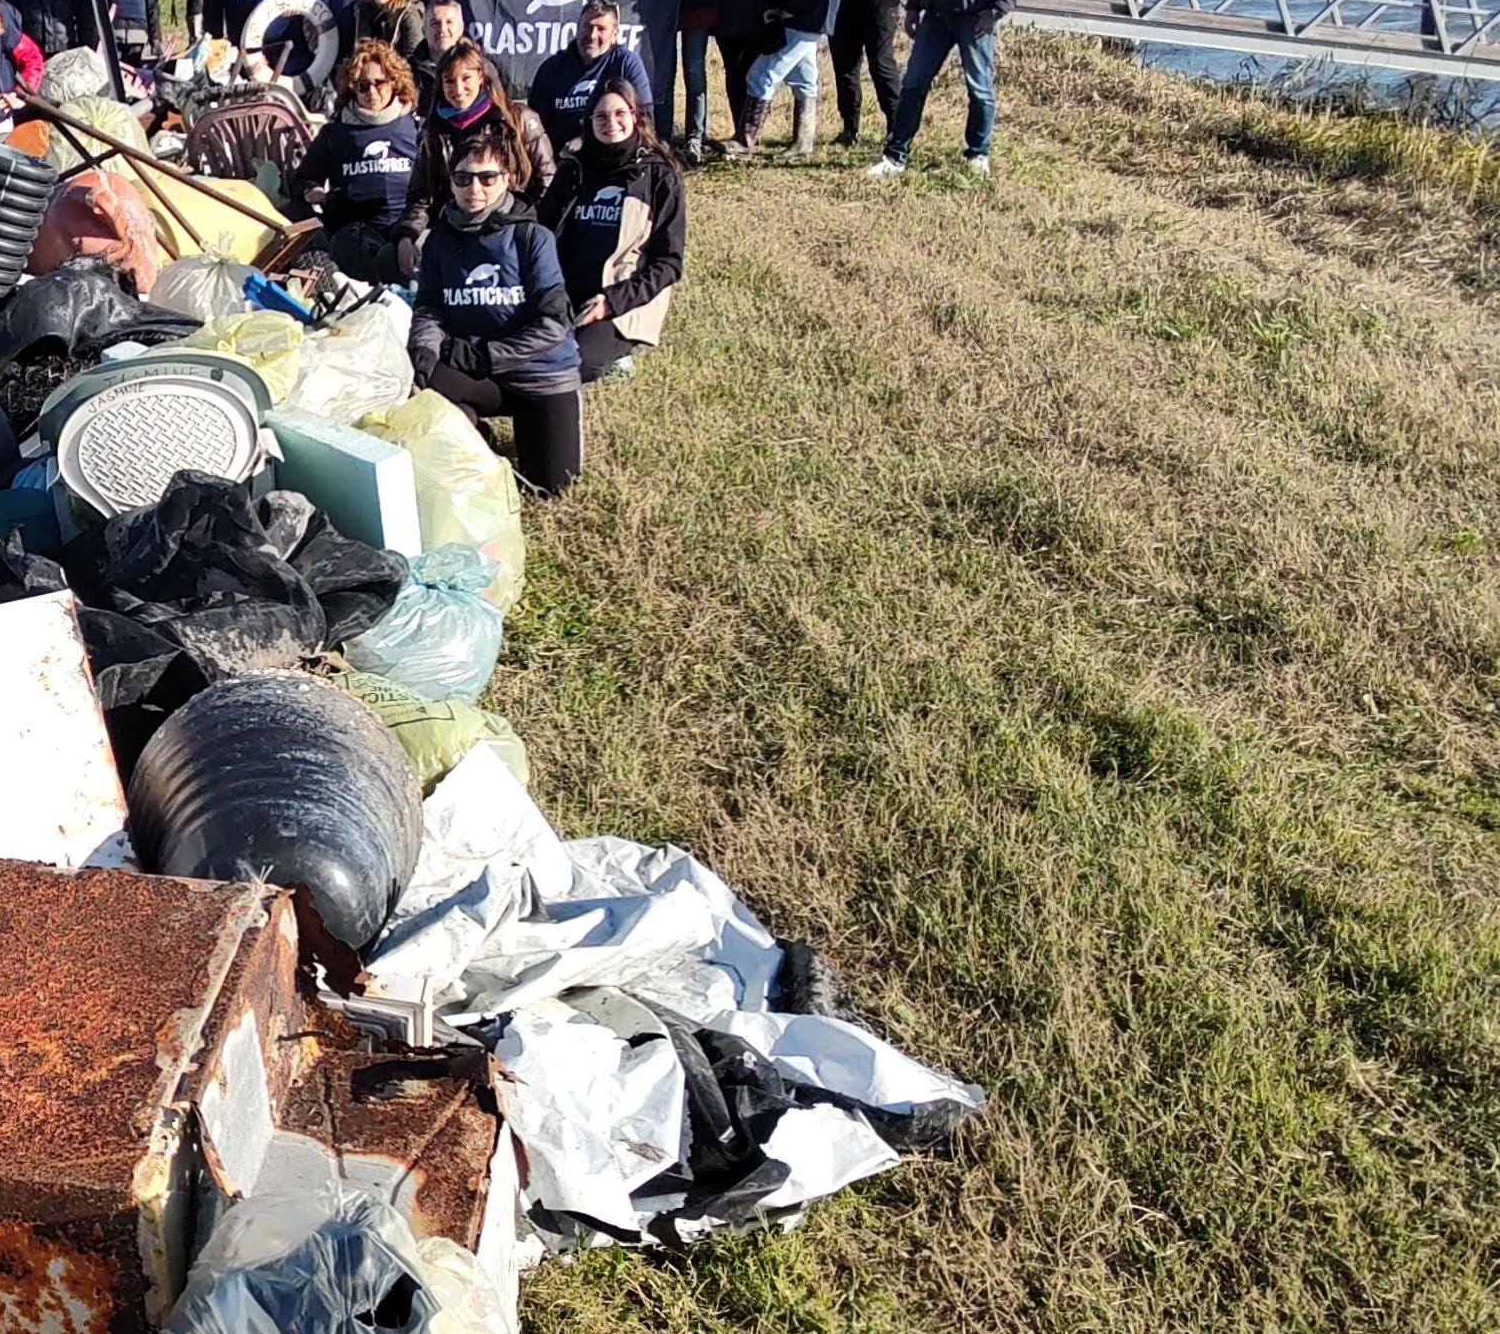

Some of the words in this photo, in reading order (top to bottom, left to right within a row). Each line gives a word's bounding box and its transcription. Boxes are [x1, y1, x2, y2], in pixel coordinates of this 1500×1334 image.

[469, 22, 644, 55] PLASTICEE
[342, 157, 412, 176] PLASTICFREE
[88, 381, 147, 415] JASMINE
